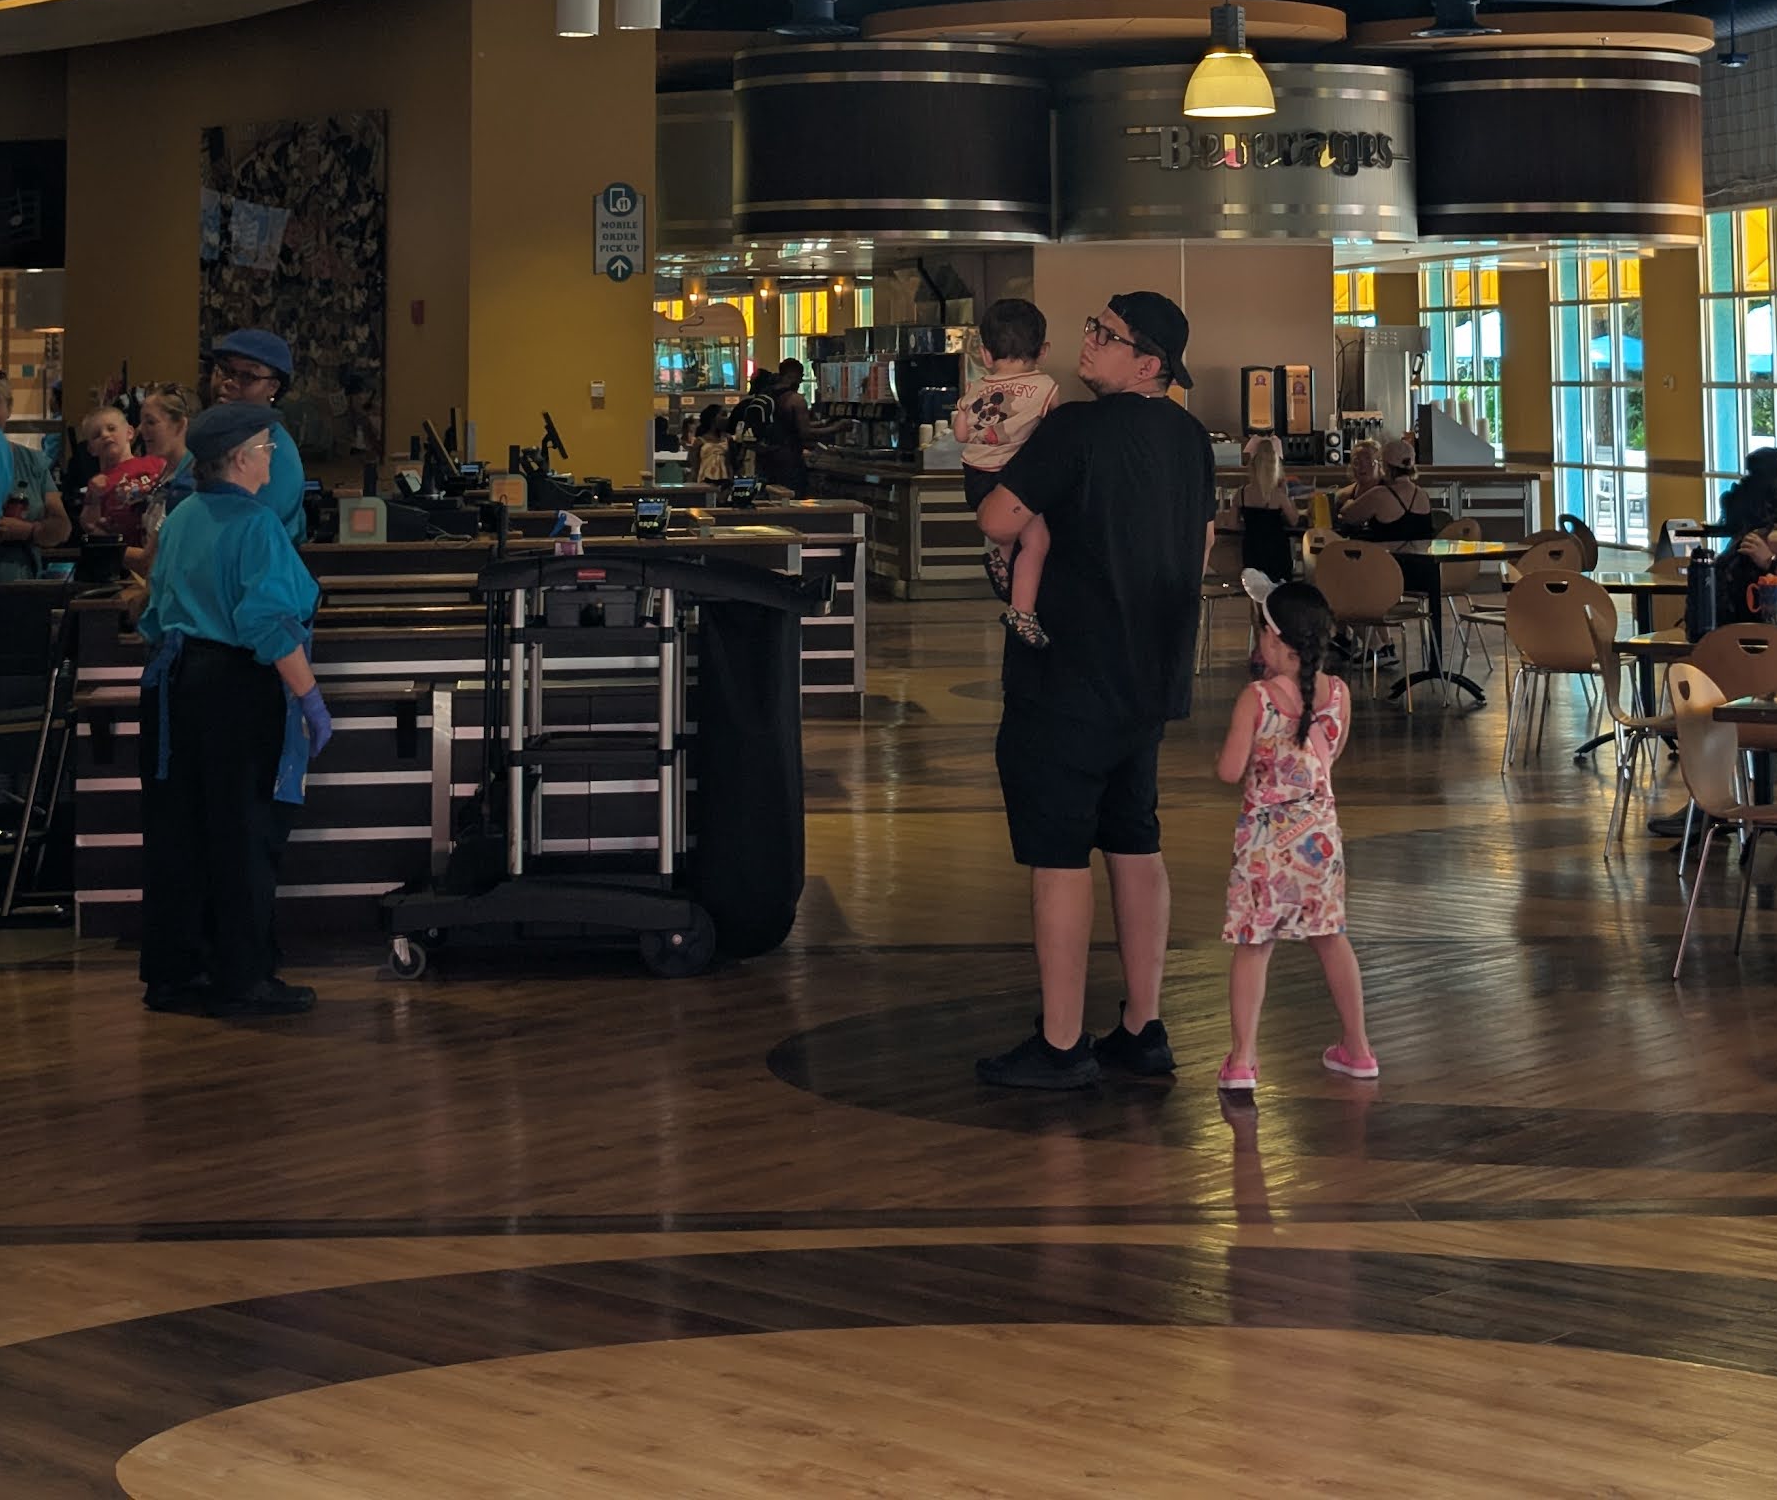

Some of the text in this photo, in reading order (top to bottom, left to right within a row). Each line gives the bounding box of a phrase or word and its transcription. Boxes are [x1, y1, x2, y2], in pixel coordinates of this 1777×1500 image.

[1158, 125, 1393, 177] Beverages
[601, 221, 638, 229] MOBILE
[602, 233, 637, 241] ORDER
[599, 244, 640, 252] PICK UP
